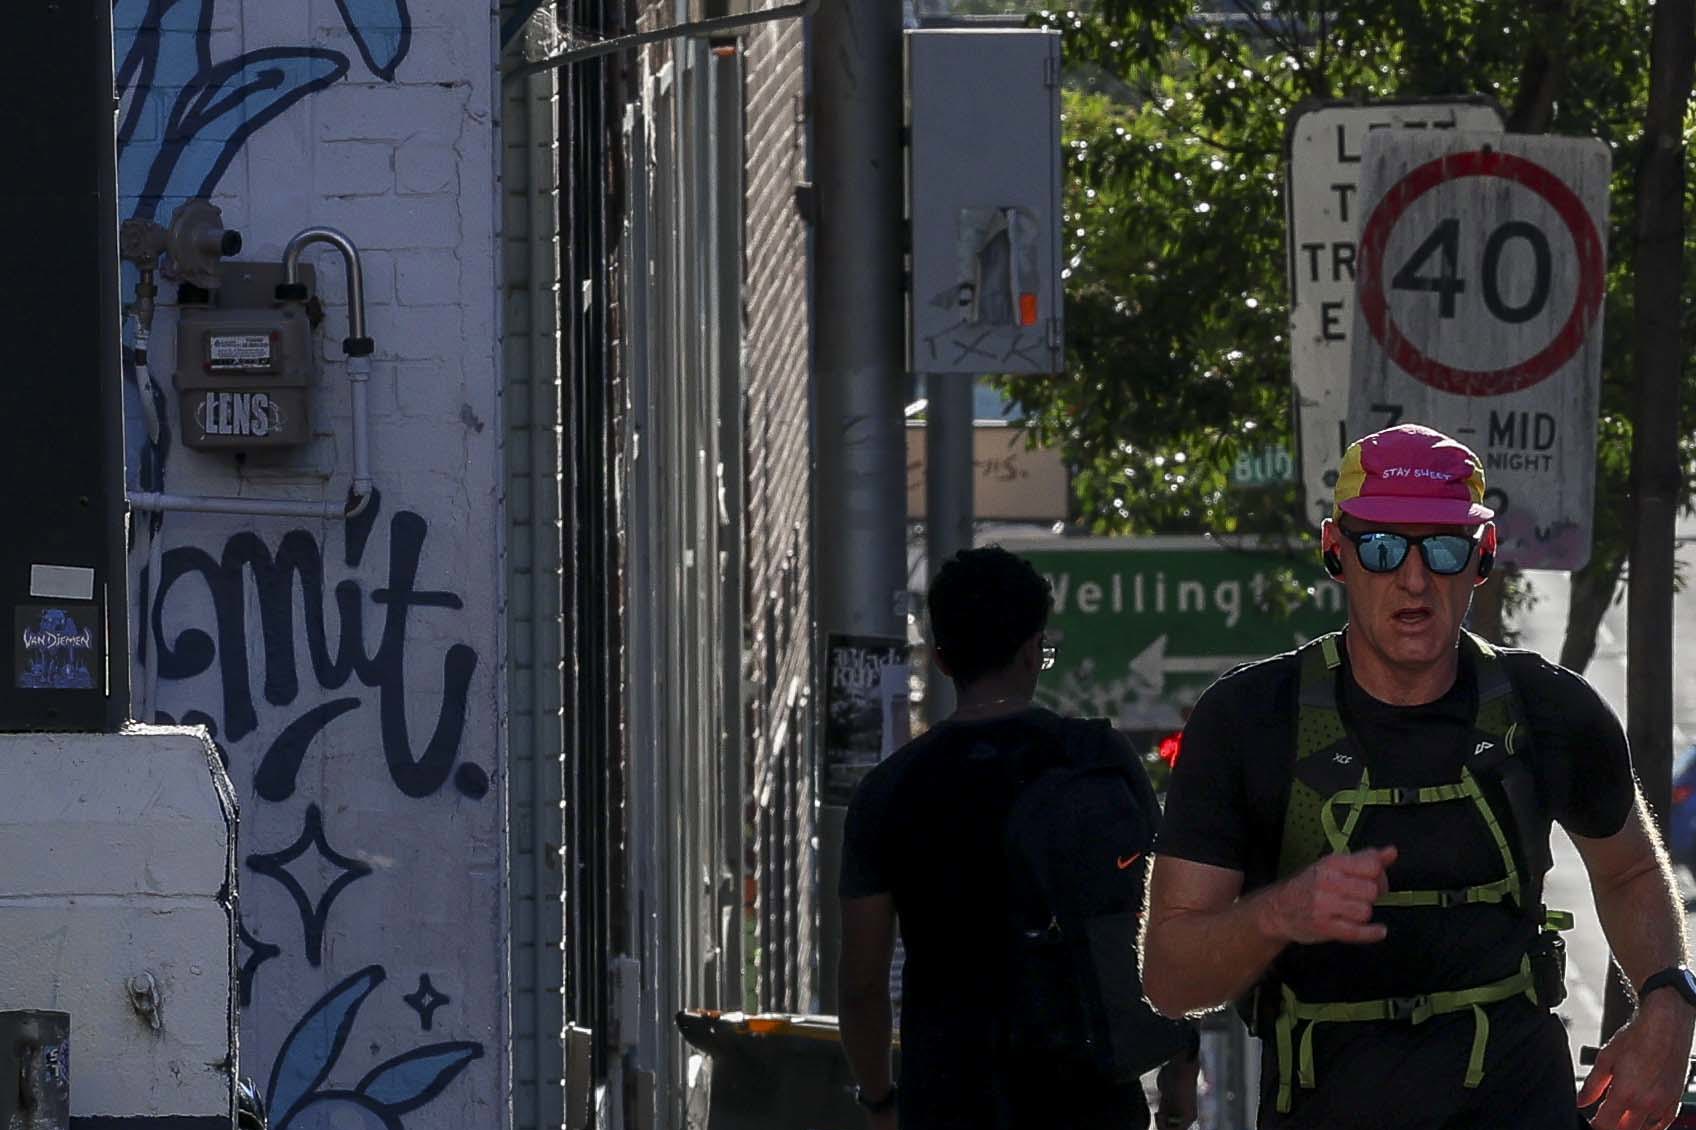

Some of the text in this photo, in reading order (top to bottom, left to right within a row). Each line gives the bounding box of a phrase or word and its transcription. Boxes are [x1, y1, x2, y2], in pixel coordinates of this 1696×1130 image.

[1391, 217, 1552, 324] 40
[205, 391, 269, 437] LENS
[1489, 410, 1556, 450] MID
[1382, 467, 1452, 481] STAY SWEET
[1487, 453, 1553, 473] NIGHT
